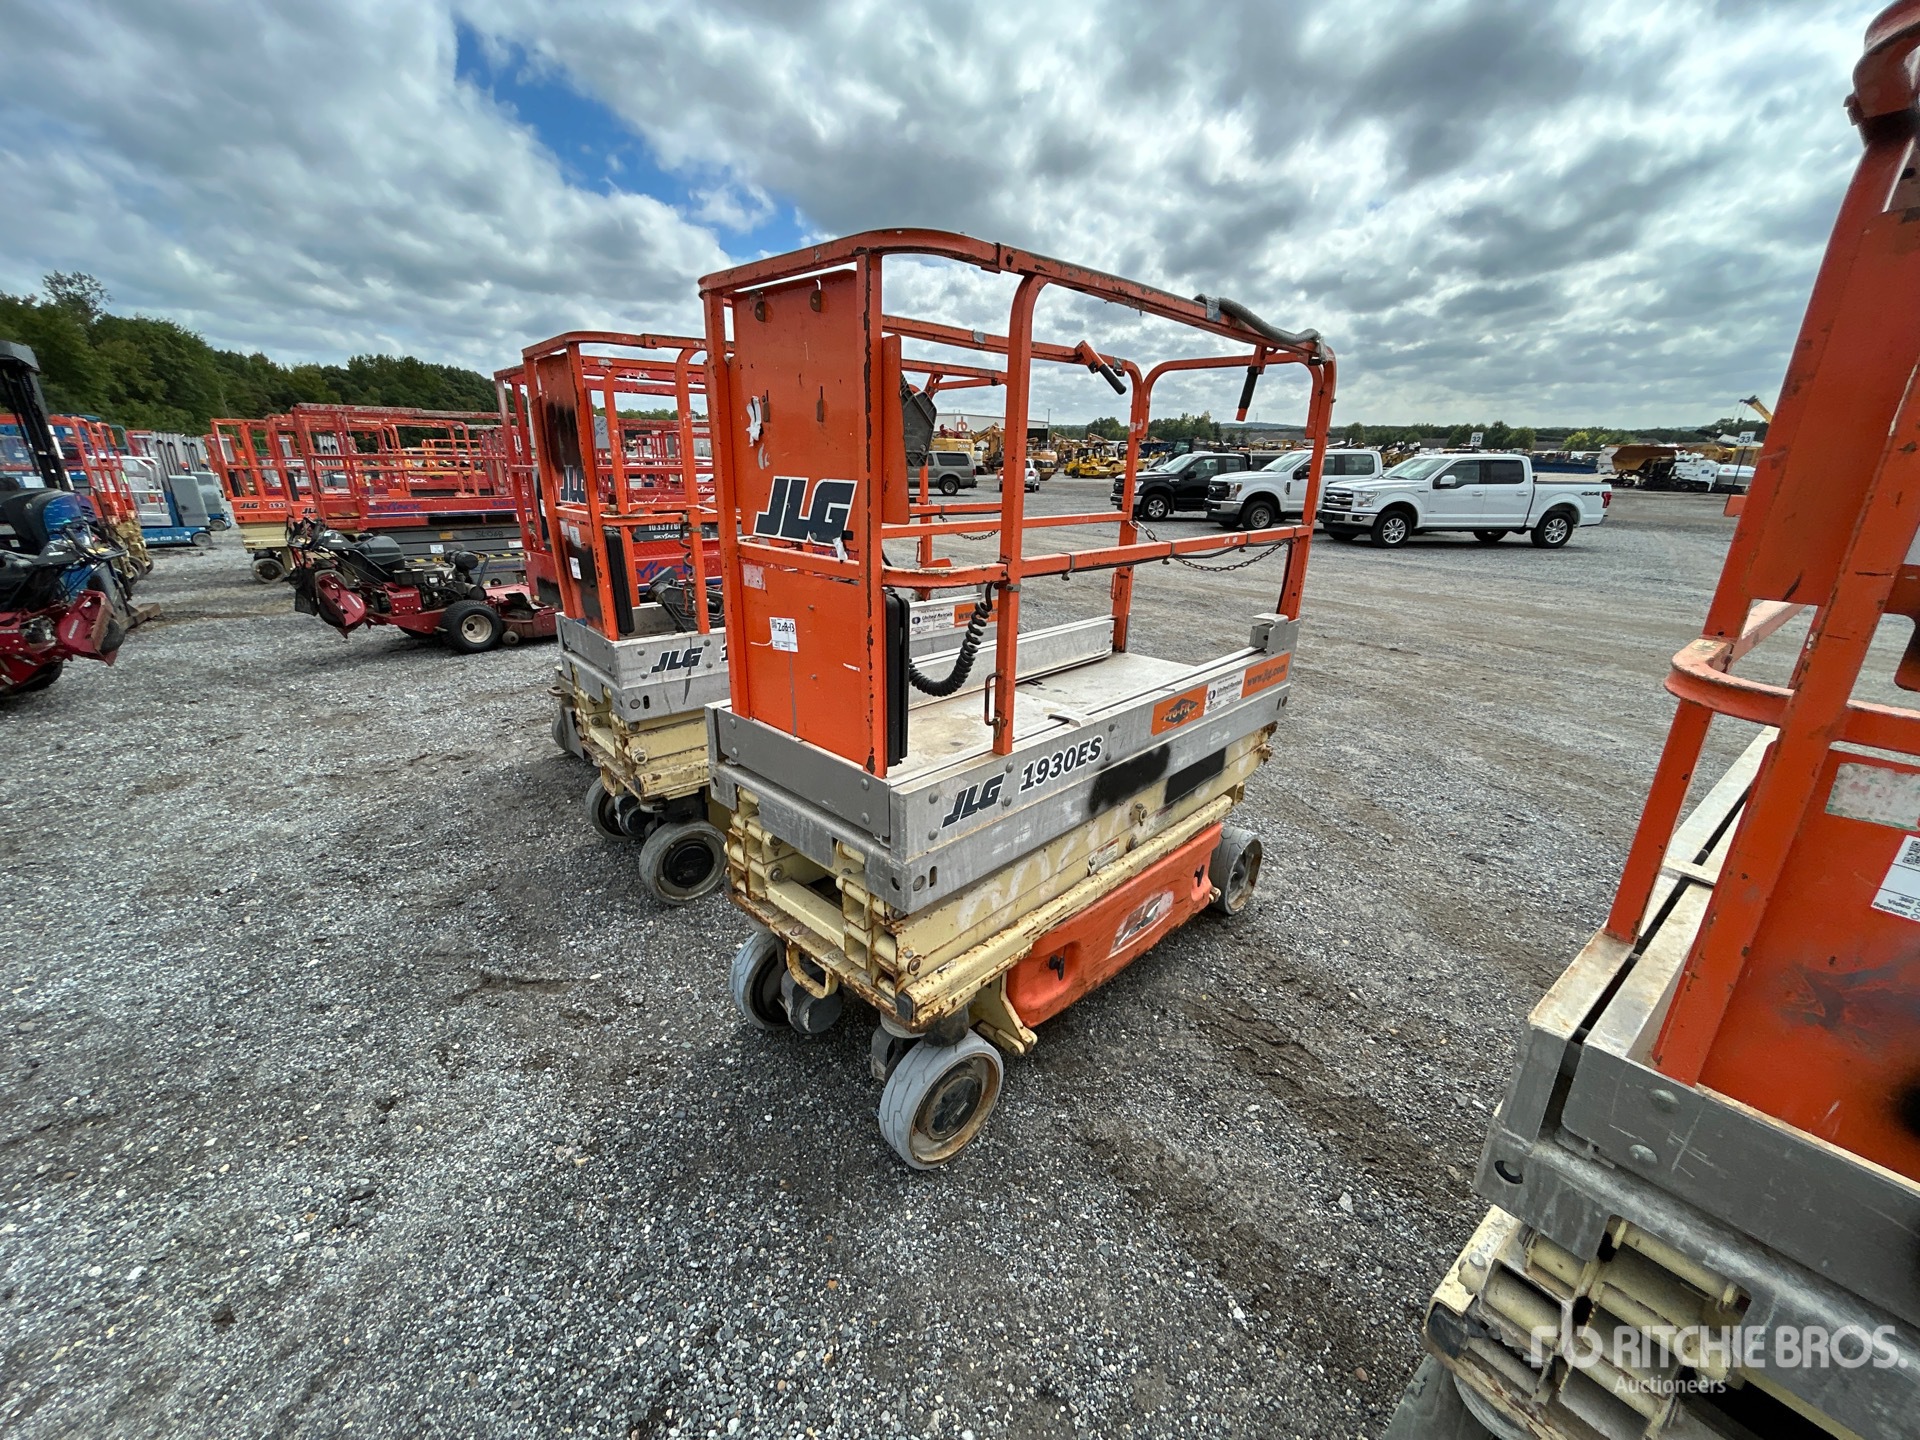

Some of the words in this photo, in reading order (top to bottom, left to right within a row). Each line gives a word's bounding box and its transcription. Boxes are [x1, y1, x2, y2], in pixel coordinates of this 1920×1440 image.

[1739, 436, 1751, 444] 33
[753, 475, 858, 547] JLG
[650, 646, 704, 674] JLG
[941, 772, 1006, 829] JLG
[1018, 735, 1104, 795] 1930ES
